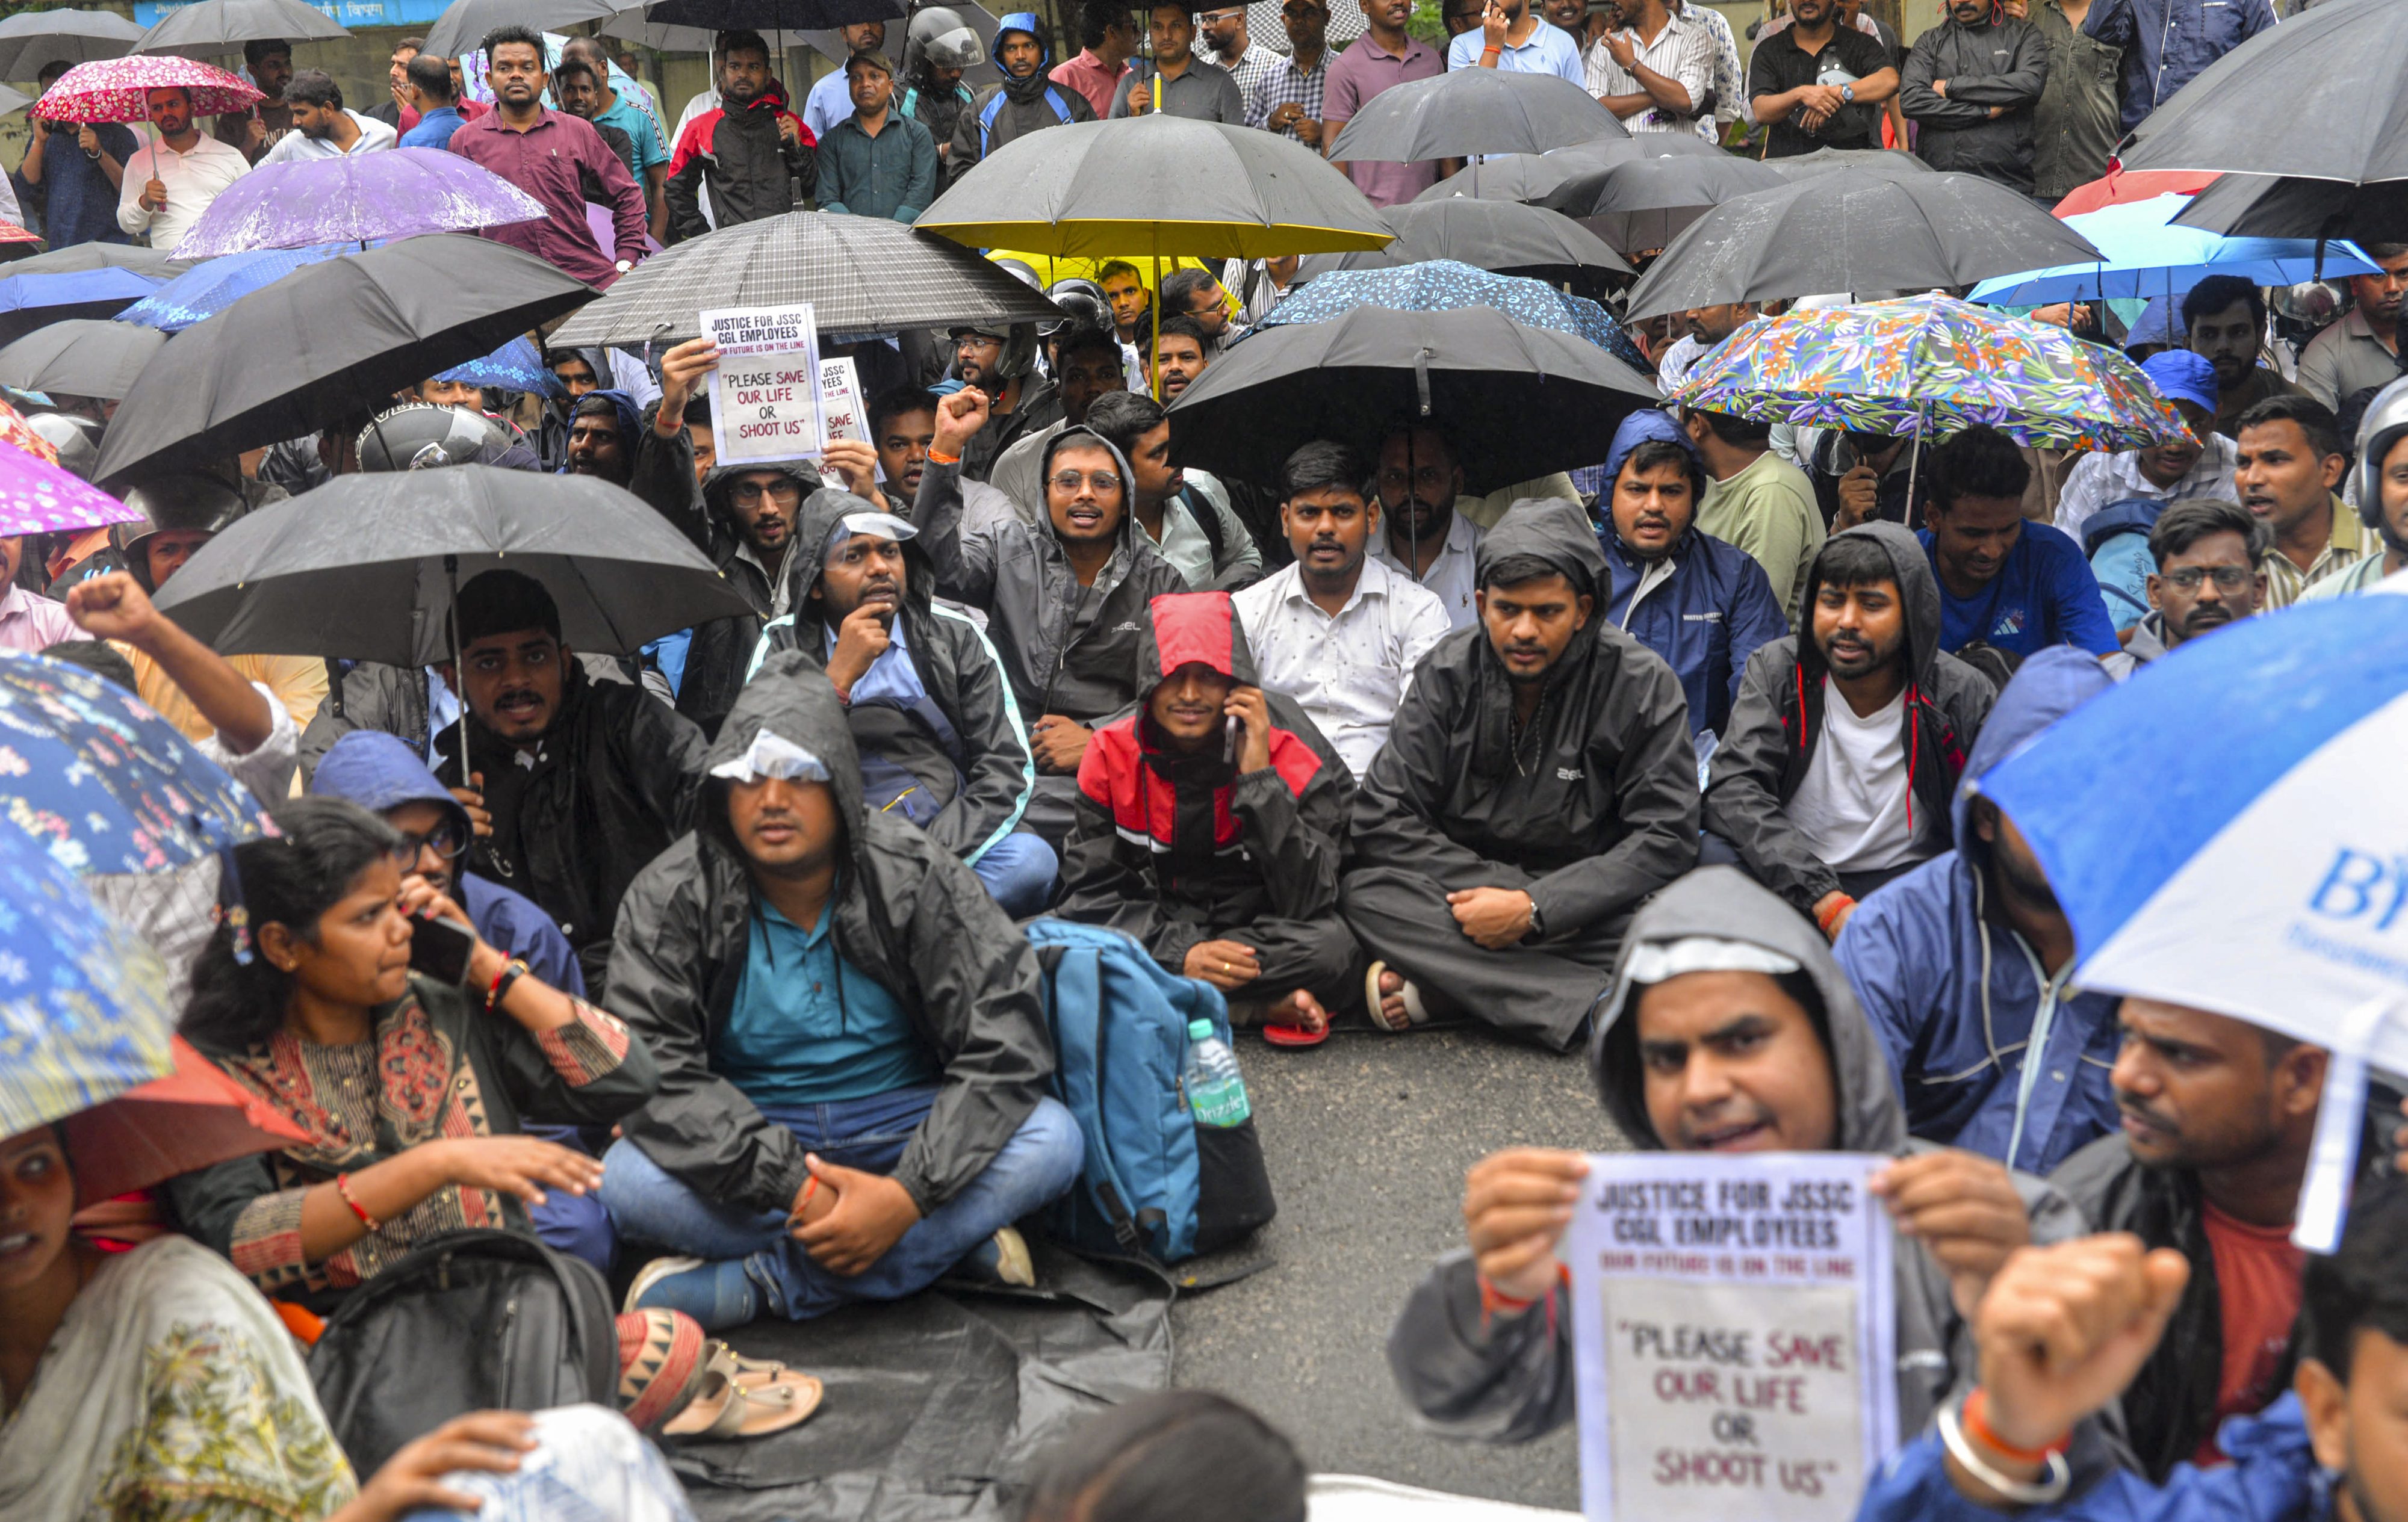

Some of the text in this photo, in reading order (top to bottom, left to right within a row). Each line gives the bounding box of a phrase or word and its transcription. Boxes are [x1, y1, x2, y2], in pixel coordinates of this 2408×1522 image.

[712, 314, 801, 331] JUSTICE FOR JSSC
[718, 326, 798, 344] CGL EMPLOYEES
[730, 345, 754, 354] FUTURE
[777, 342, 788, 350] THE
[790, 341, 805, 349] LINE
[776, 370, 805, 385] SAVE
[824, 365, 845, 377] JSSC
[822, 376, 842, 389] YEES
[737, 388, 792, 404] OUR LIFE
[836, 387, 849, 396] LINE
[759, 406, 777, 419] OR
[828, 413, 852, 429] SAVE
[739, 422, 780, 438] SHOOT
[1597, 1180, 1854, 1213] JUSTICE FOR JSSC
[1613, 1216, 1839, 1248] CGL EMPLOYEES
[1773, 1255, 1805, 1276] THE
[1765, 1331, 1846, 1373] SAVE
[1654, 1367, 1808, 1414] OUR LIFE
[1711, 1411, 1760, 1447] OR
[1654, 1447, 1766, 1487] SHOOT
